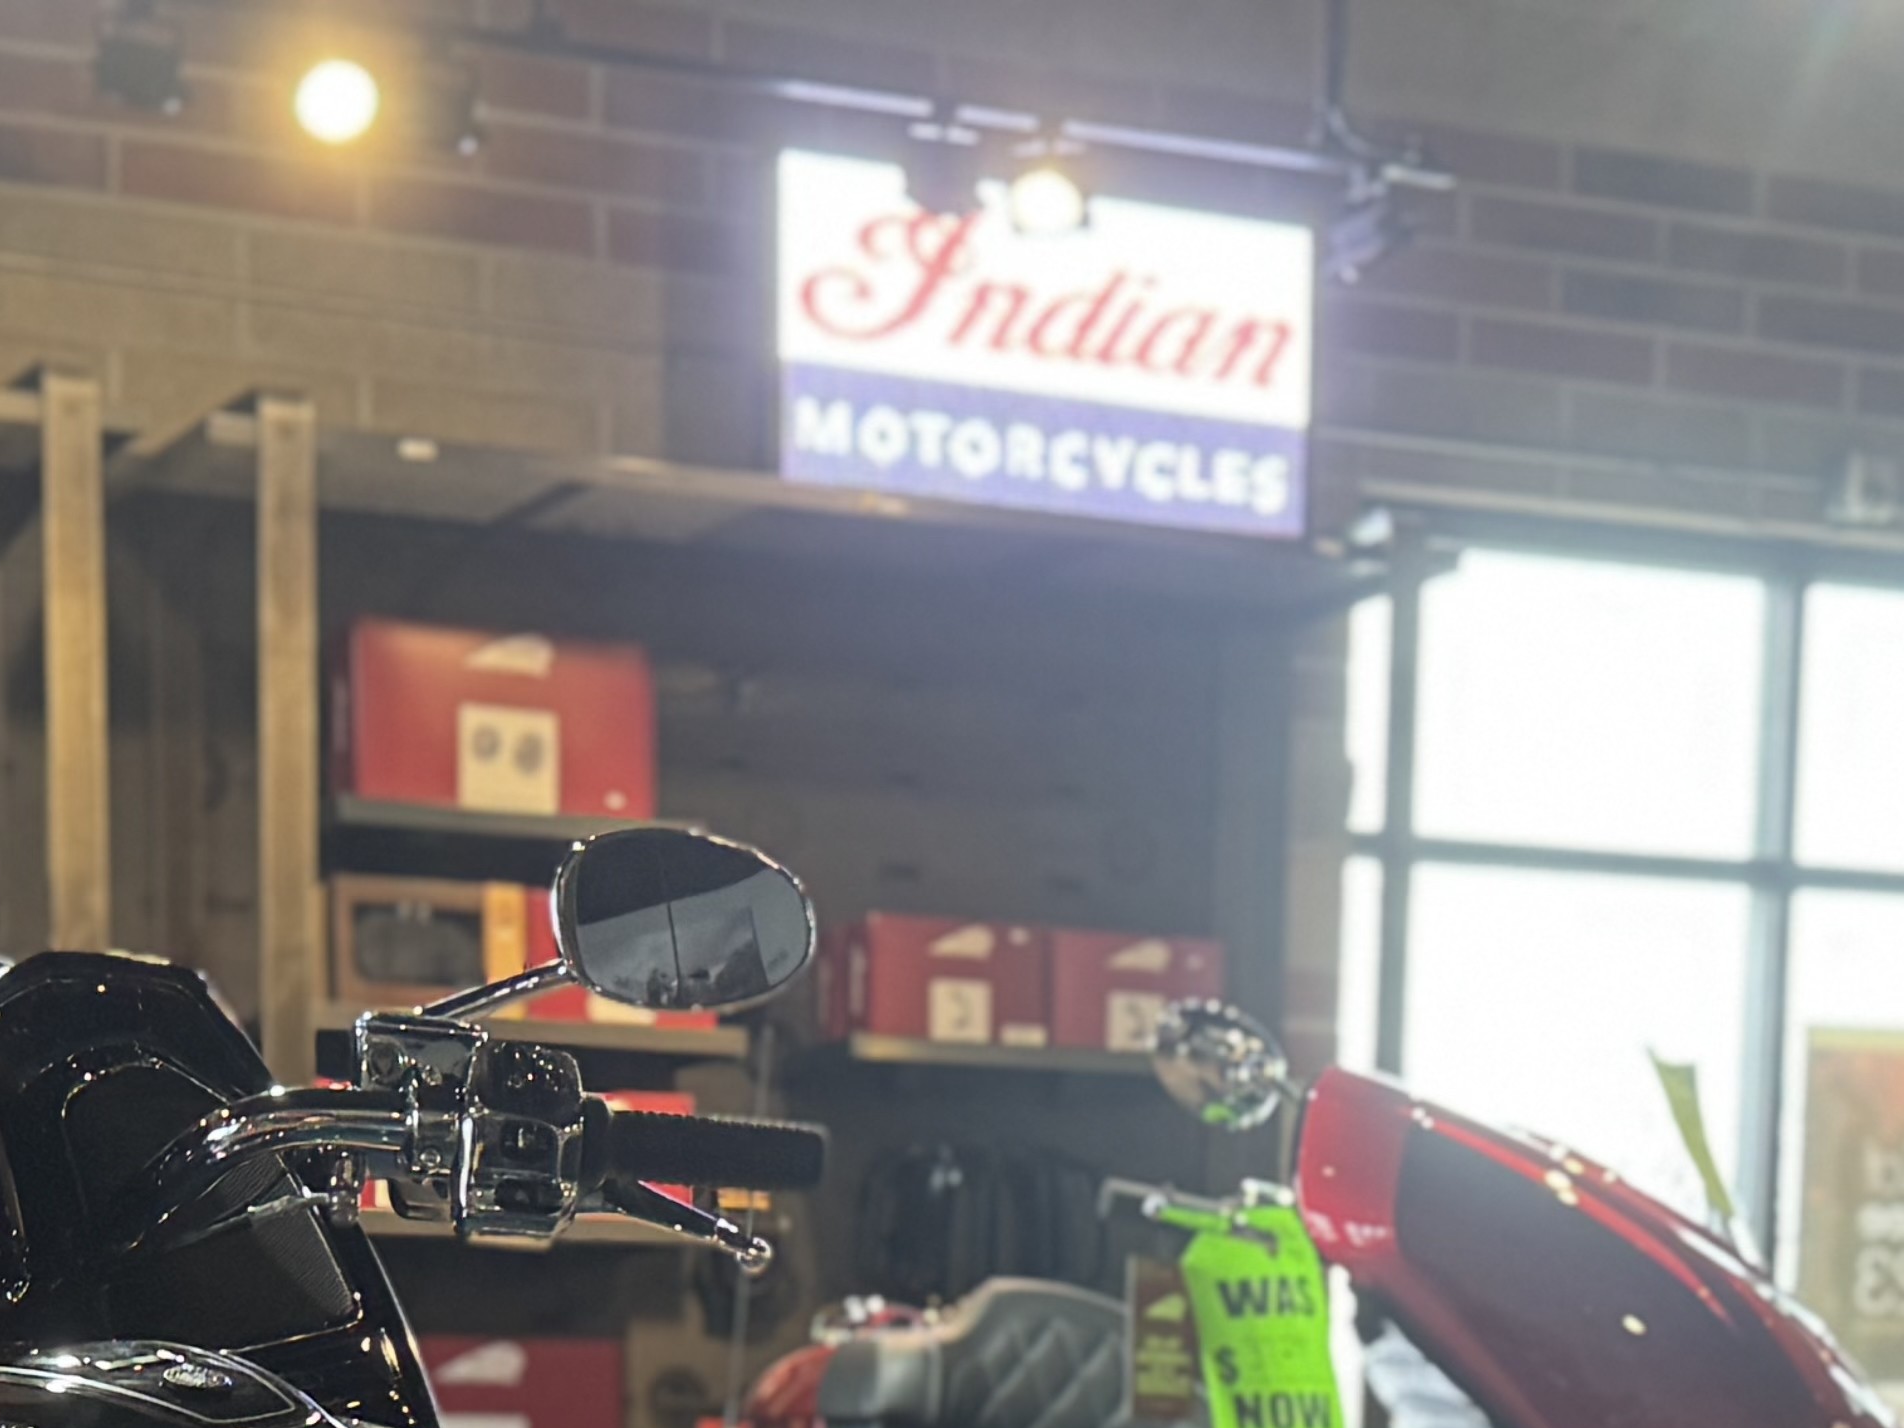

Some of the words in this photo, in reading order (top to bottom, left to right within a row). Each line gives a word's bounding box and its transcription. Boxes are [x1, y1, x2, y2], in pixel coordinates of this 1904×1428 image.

[799, 207, 1293, 388] Indian
[793, 397, 1290, 517] MOTORCYCLES
[1217, 1276, 1316, 1319] WAS
